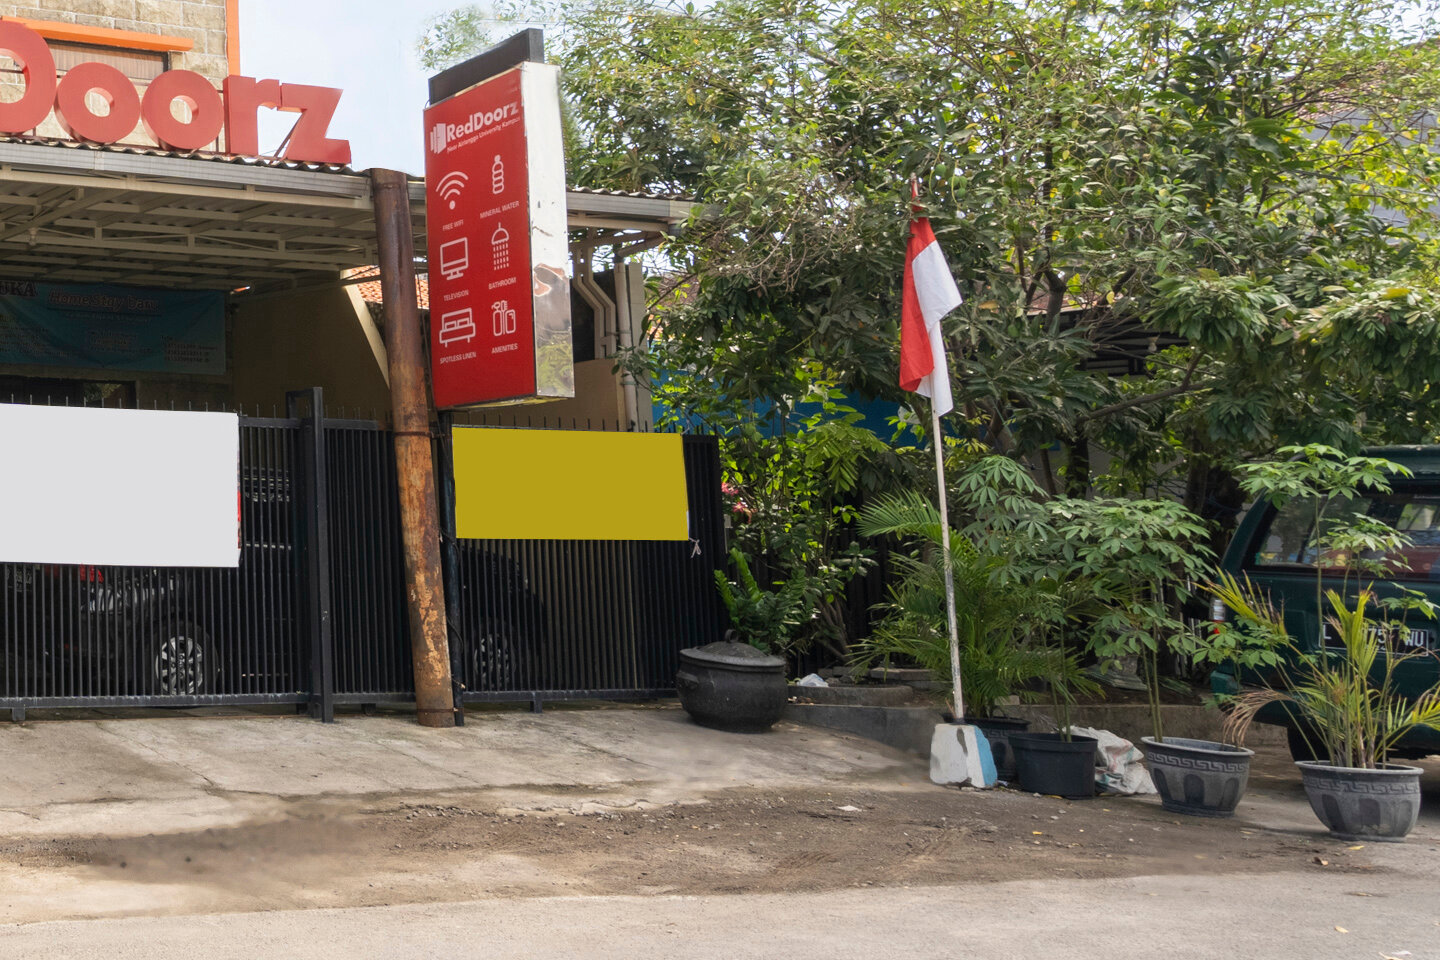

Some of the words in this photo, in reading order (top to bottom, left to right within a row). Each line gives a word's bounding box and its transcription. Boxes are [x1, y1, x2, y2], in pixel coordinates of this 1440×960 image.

[447, 101, 519, 143] RedDoorz
[480, 206, 501, 219] MINERAL
[501, 200, 520, 212] WATER
[442, 222, 454, 231] FREE
[488, 276, 517, 290] BATHROOM
[443, 289, 469, 302] TELEVISION
[491, 343, 519, 355] AMENITIES
[440, 354, 462, 364] SPOTLESS
[462, 351, 477, 360] LINEN
[1323, 624, 1332, 640] L
